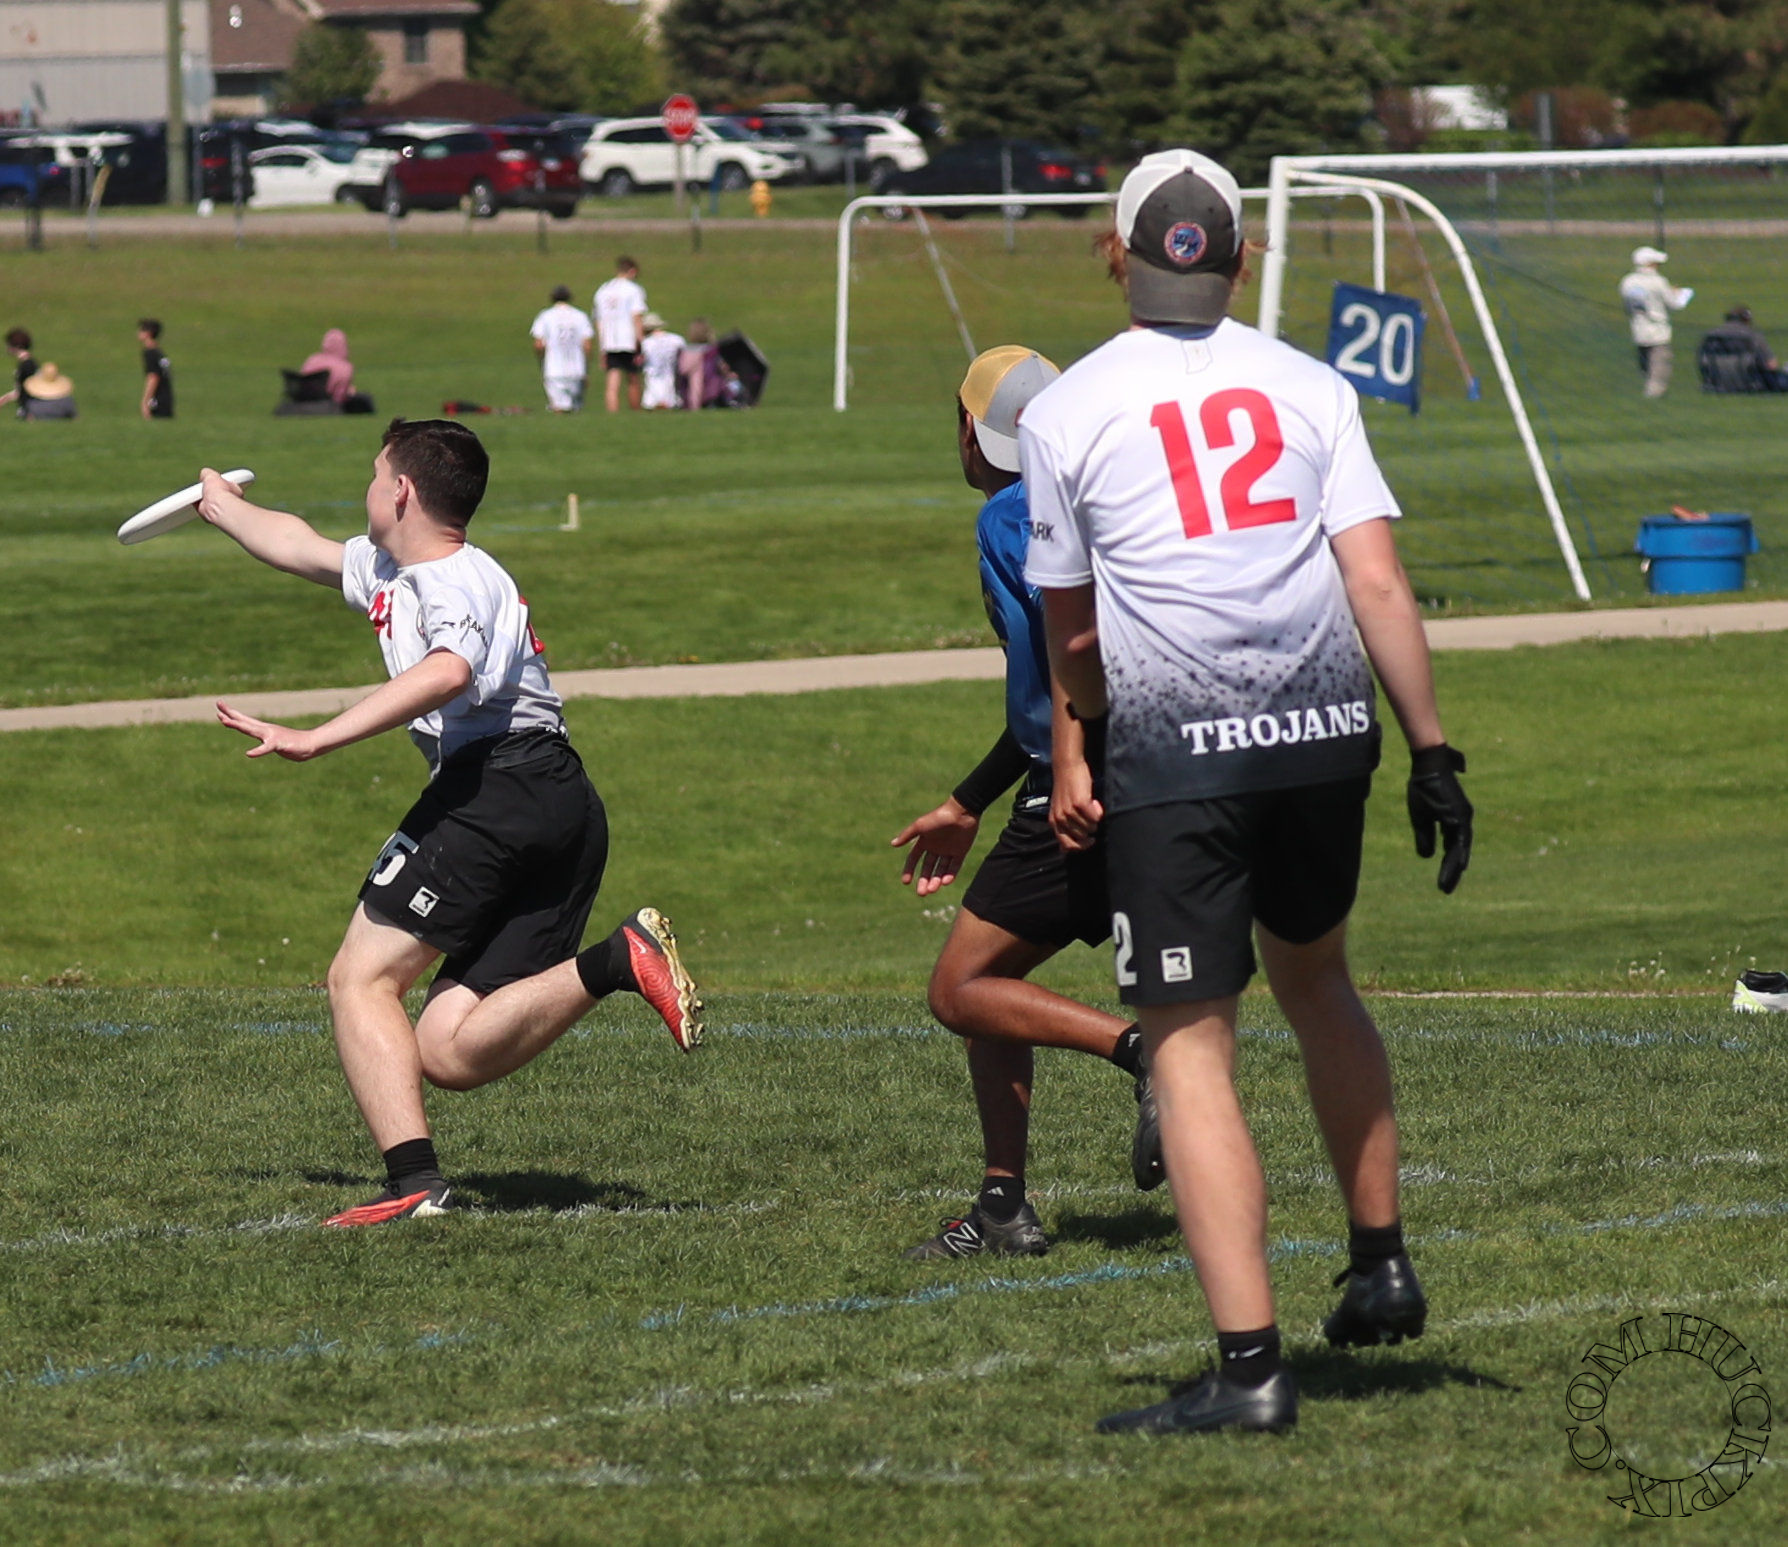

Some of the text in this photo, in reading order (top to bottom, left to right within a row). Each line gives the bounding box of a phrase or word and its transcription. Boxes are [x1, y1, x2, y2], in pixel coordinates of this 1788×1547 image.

[1335, 303, 1414, 386] 20
[1150, 387, 1297, 539] 12
[1181, 701, 1370, 755] TROJANS
